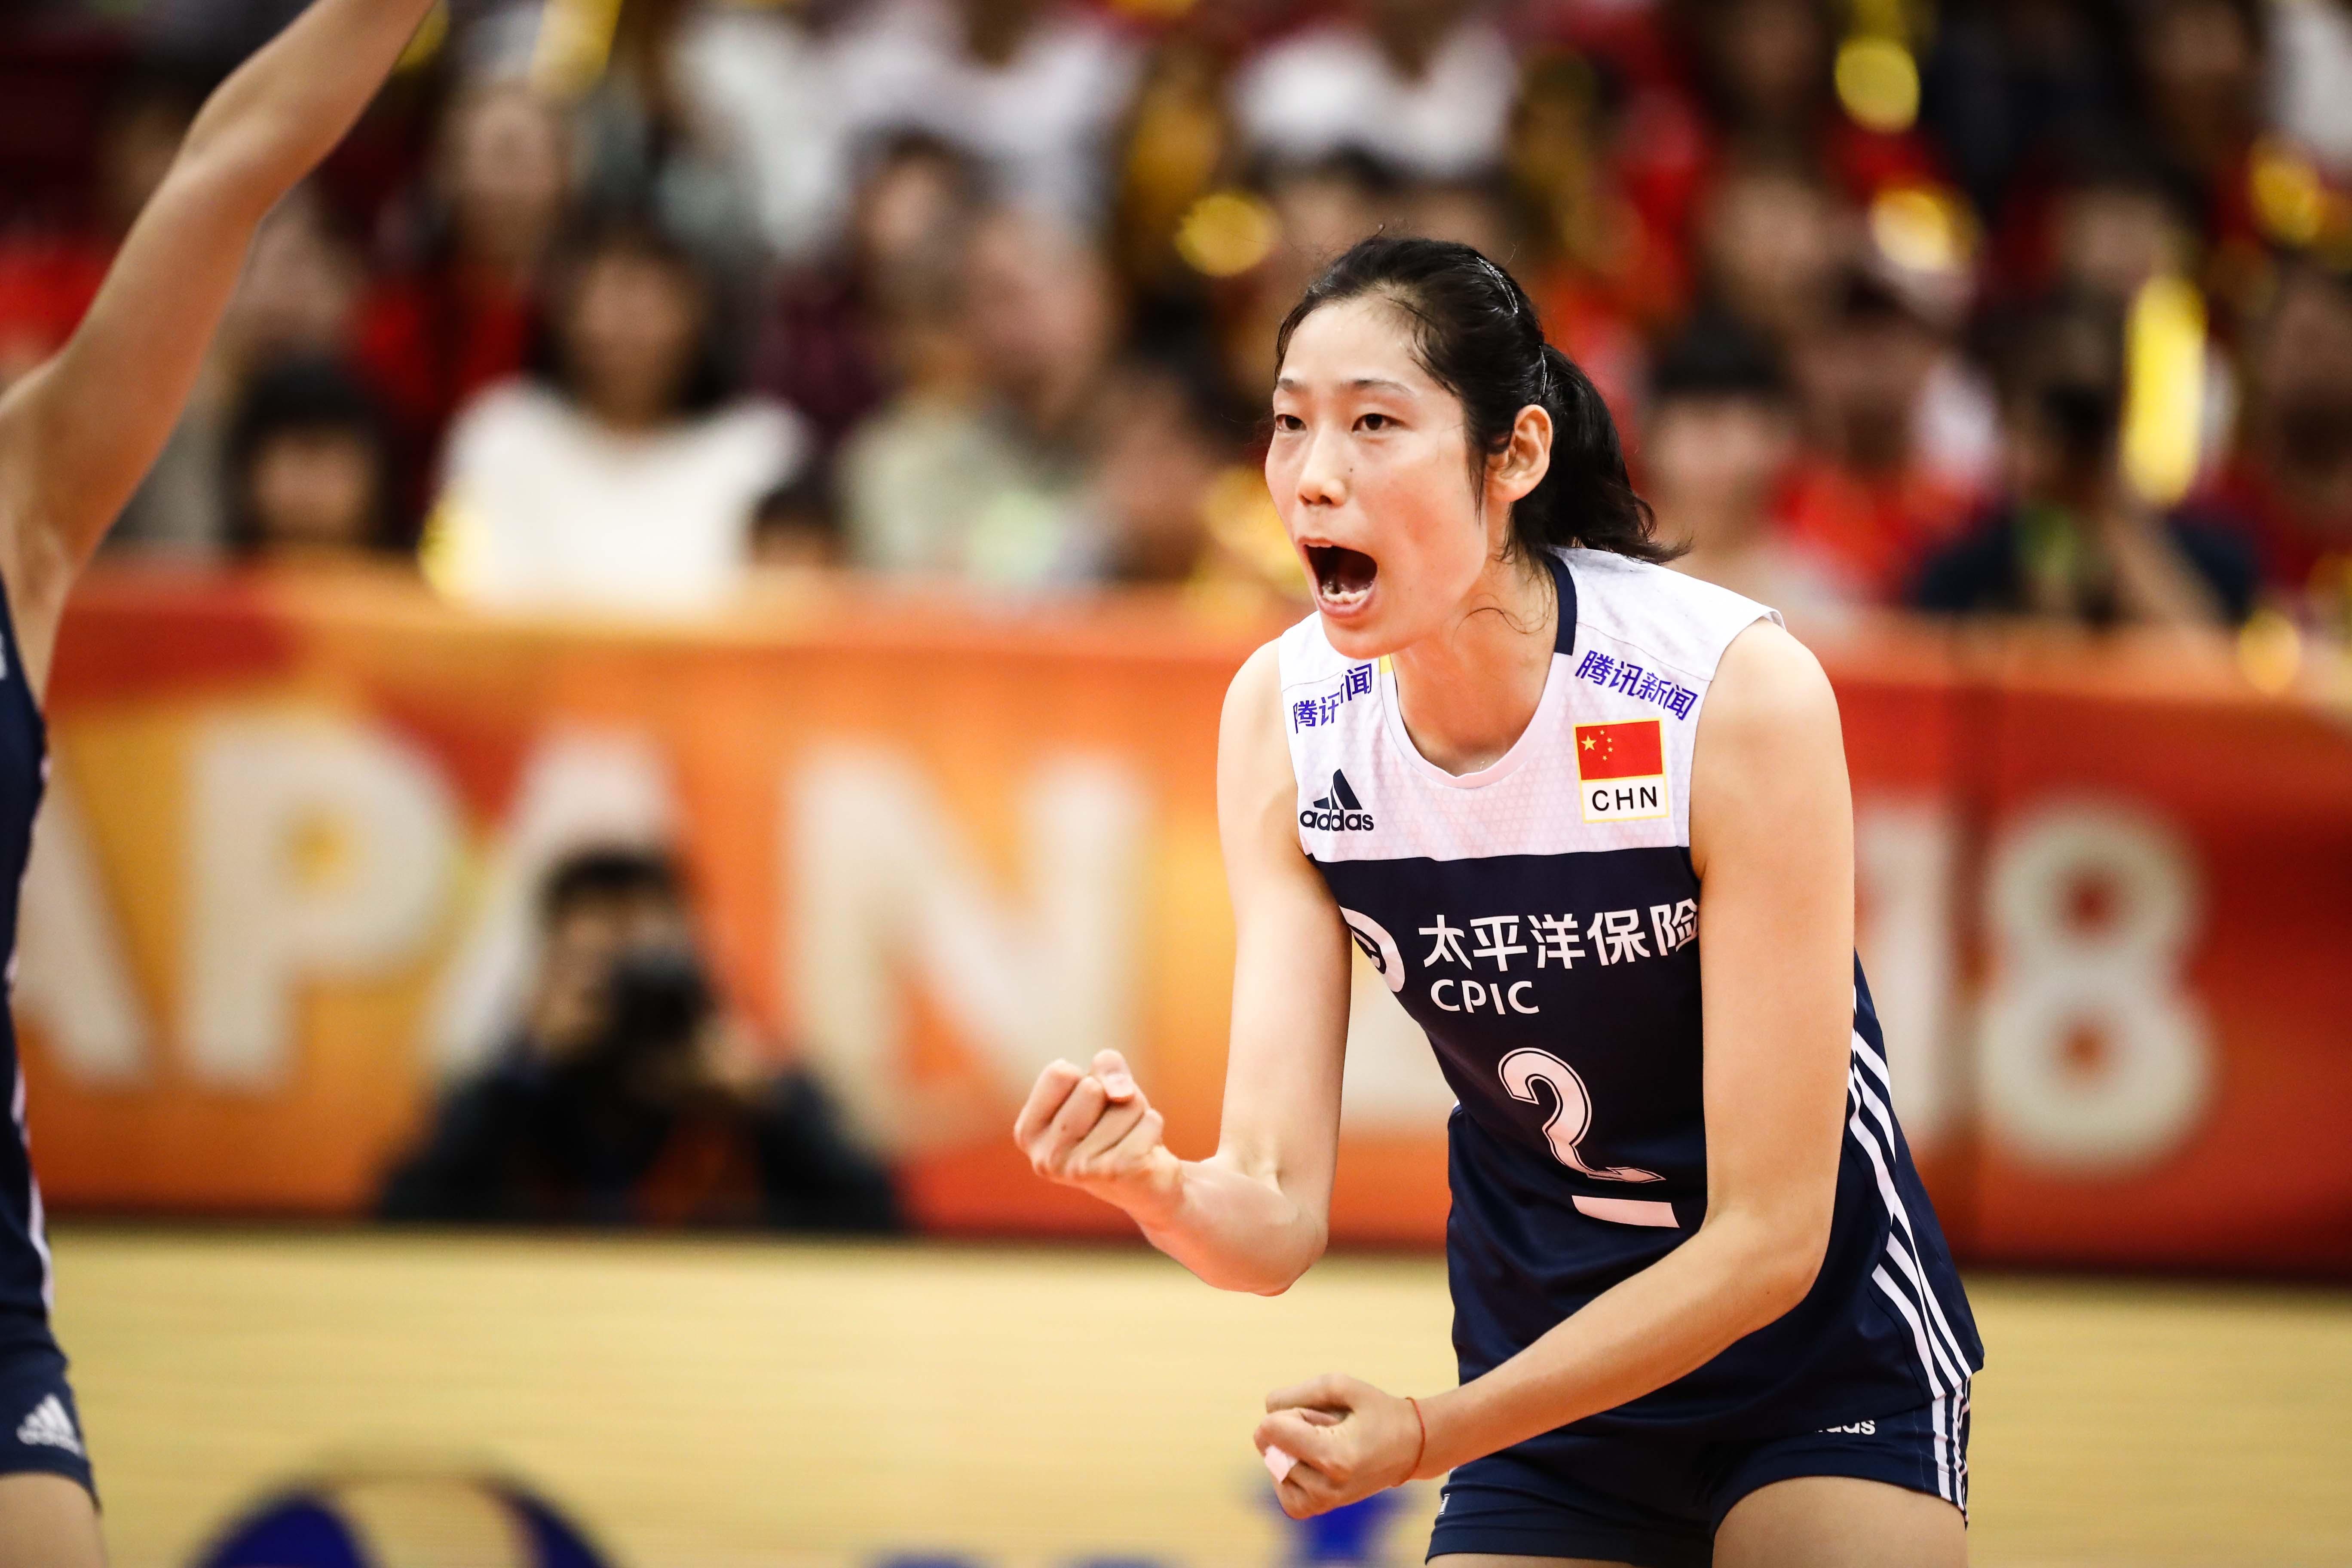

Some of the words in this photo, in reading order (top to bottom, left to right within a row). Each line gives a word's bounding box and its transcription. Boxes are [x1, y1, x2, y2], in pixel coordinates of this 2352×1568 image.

[1575, 650, 1698, 720] 腾讯新闻
[1300, 809, 1374, 831] addas
[1592, 786, 1657, 812] CHN
[1418, 898, 1697, 971] 太平洋保险
[1430, 979, 1540, 1015] CPIC
[1498, 1047, 1680, 1228] 2
